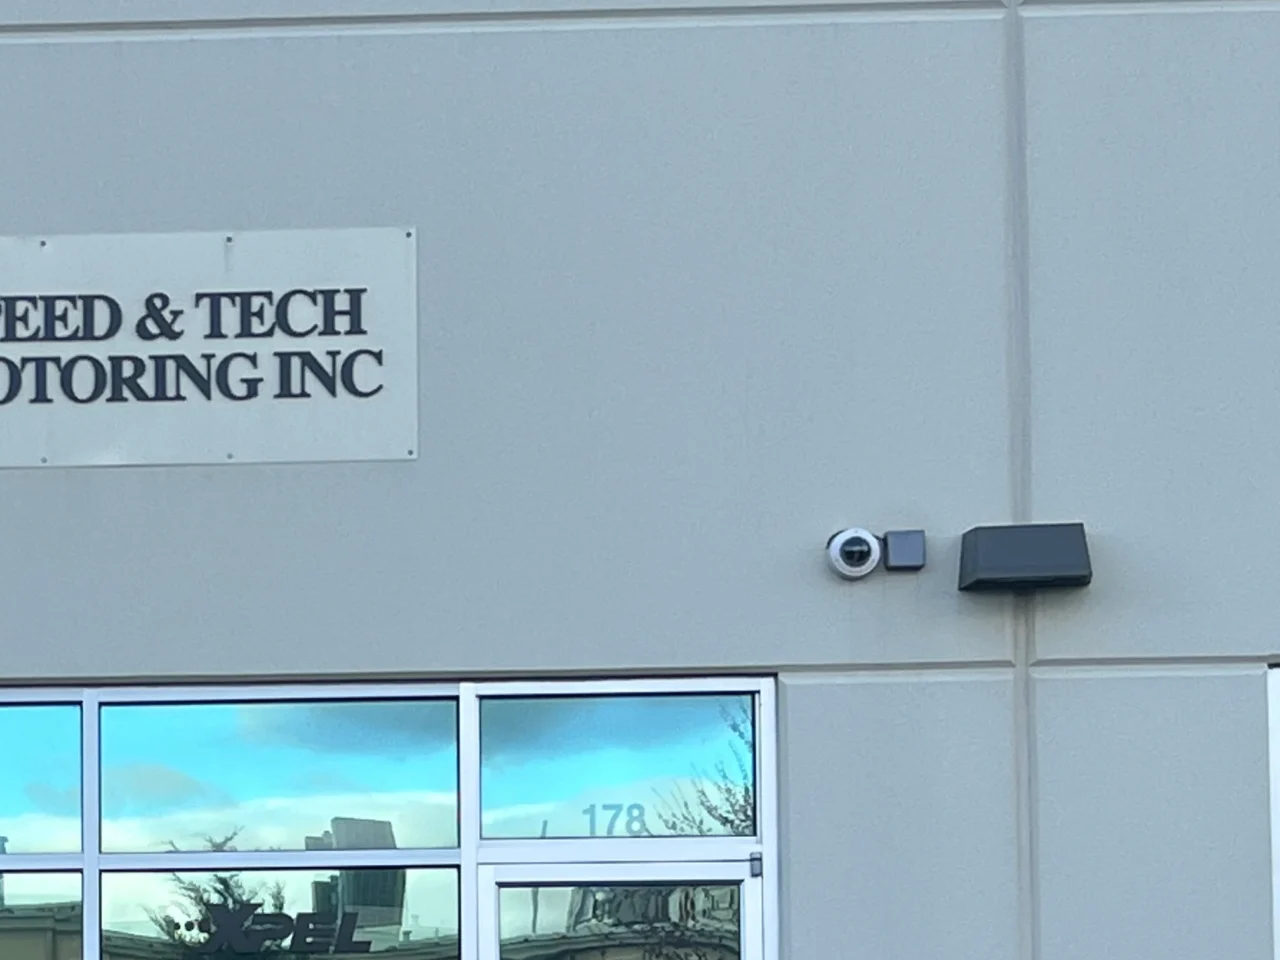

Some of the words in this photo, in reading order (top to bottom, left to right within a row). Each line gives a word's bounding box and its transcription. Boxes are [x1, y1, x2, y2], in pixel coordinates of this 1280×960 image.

[135, 292, 185, 342] &
[194, 287, 368, 340] TECH
[272, 349, 384, 399] INC
[582, 803, 645, 836] 178
[200, 903, 372, 953] XPEL
